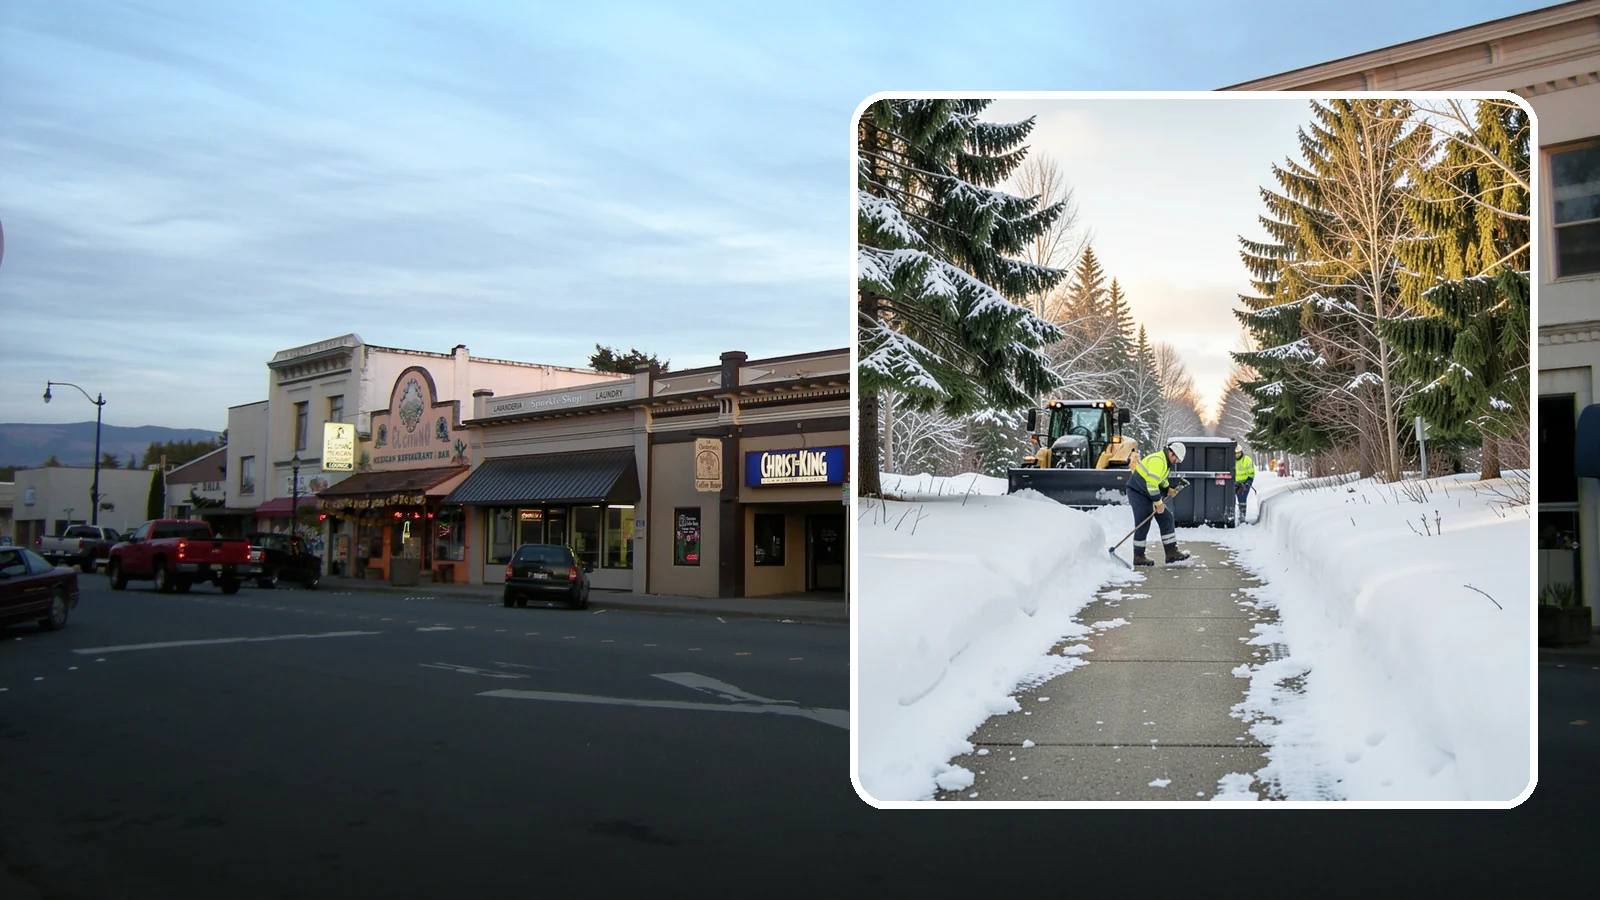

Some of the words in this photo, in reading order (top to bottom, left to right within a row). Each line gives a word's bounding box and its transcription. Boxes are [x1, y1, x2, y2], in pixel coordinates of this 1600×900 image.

[531, 396, 561, 408] Sparkle
[562, 394, 582, 404] Shop
[595, 389, 623, 400] LAUNDRY
[493, 402, 522, 412] LAVANDERIA
[373, 454, 396, 464] MEXICAN
[397, 451, 434, 463] RESTAURANT
[437, 450, 450, 459] BAR
[760, 452, 797, 478] CHRIST
[799, 450, 827, 476] KING
